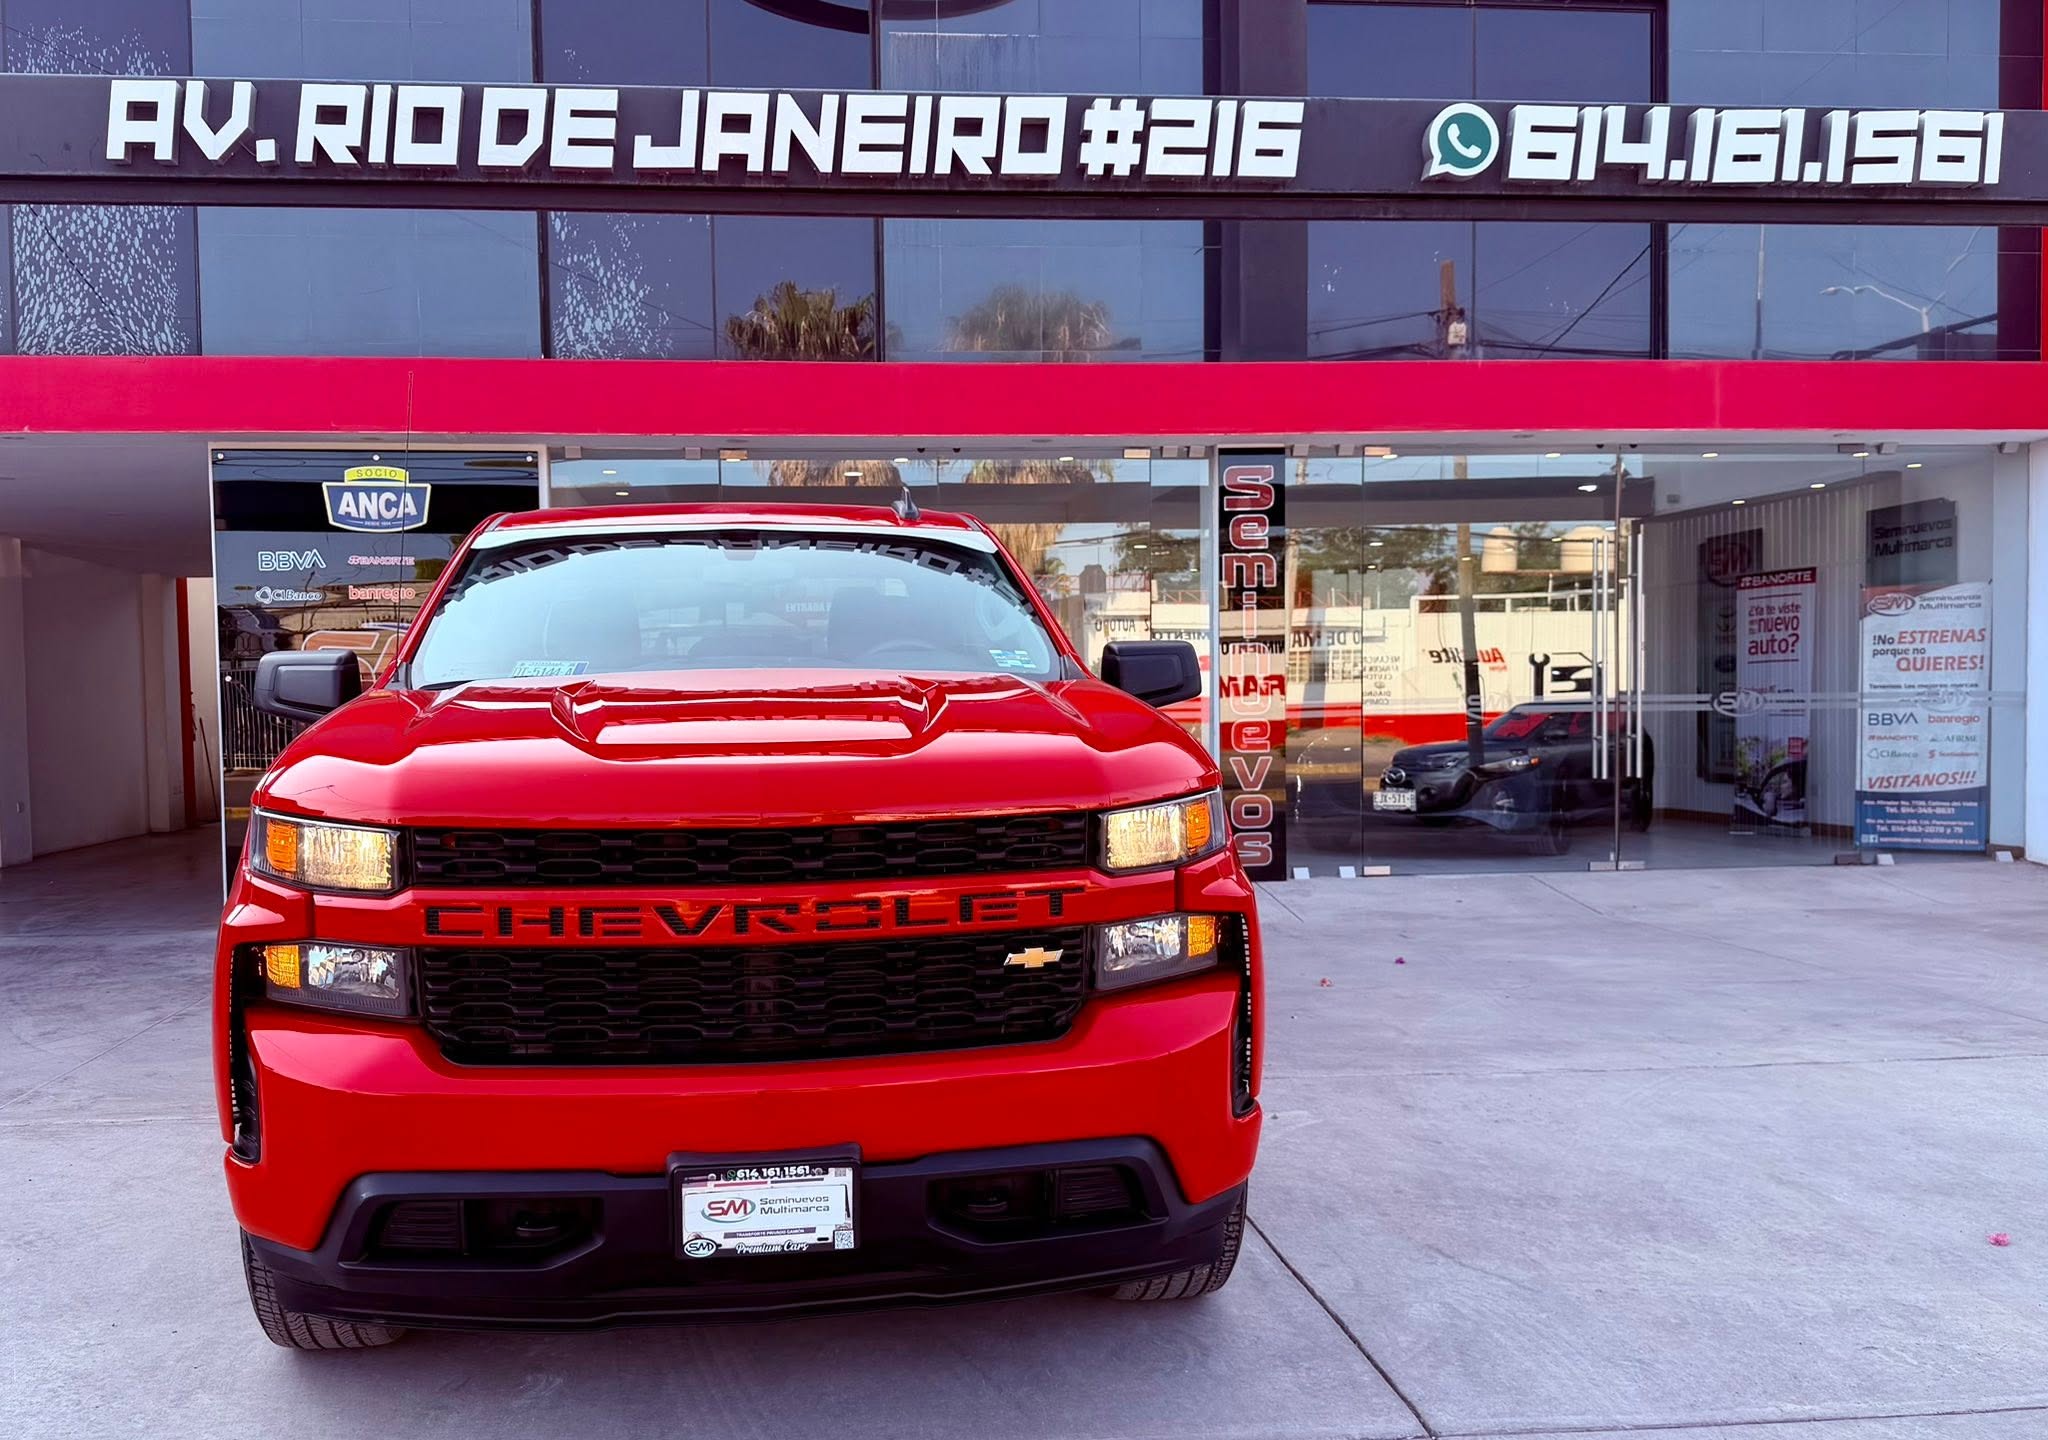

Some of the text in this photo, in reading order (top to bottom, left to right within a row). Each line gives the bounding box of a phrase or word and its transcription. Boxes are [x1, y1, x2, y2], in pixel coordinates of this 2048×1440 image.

[105, 80, 1305, 179] AV. RIO DE JANEIRO #216
[1507, 104, 2004, 186] 614.161.1561
[356, 468, 398, 479] SOCIO
[337, 491, 418, 520] ANCA
[1874, 519, 1953, 539] Seminuevos
[1874, 537, 1953, 557] Multimarca
[257, 549, 327, 572] BBVA
[360, 556, 416, 566] BANORTE
[1752, 569, 1812, 586] BANORTE
[348, 585, 416, 602] banregio
[1918, 594, 1982, 602] Seminuevos
[1778, 603, 1801, 614] viste
[1918, 602, 1982, 610] Multimarca
[1758, 616, 1800, 633] nuevo
[1748, 633, 1800, 655] auto?
[1897, 628, 1986, 645] ESTRENAS
[1872, 646, 1926, 657] porque no
[1896, 655, 1984, 672] QUIERES!
[1868, 712, 1918, 726] BBVA
[1928, 714, 1980, 725] banregio
[1867, 770, 1977, 789] VISITANOS!!!
[421, 884, 1087, 938] CHEVROLET
[707, 1199, 749, 1217] SM
[759, 1196, 829, 1206] Seminuevos
[759, 1205, 830, 1215] Multimarca
[735, 1239, 809, 1254] Premium Cars
